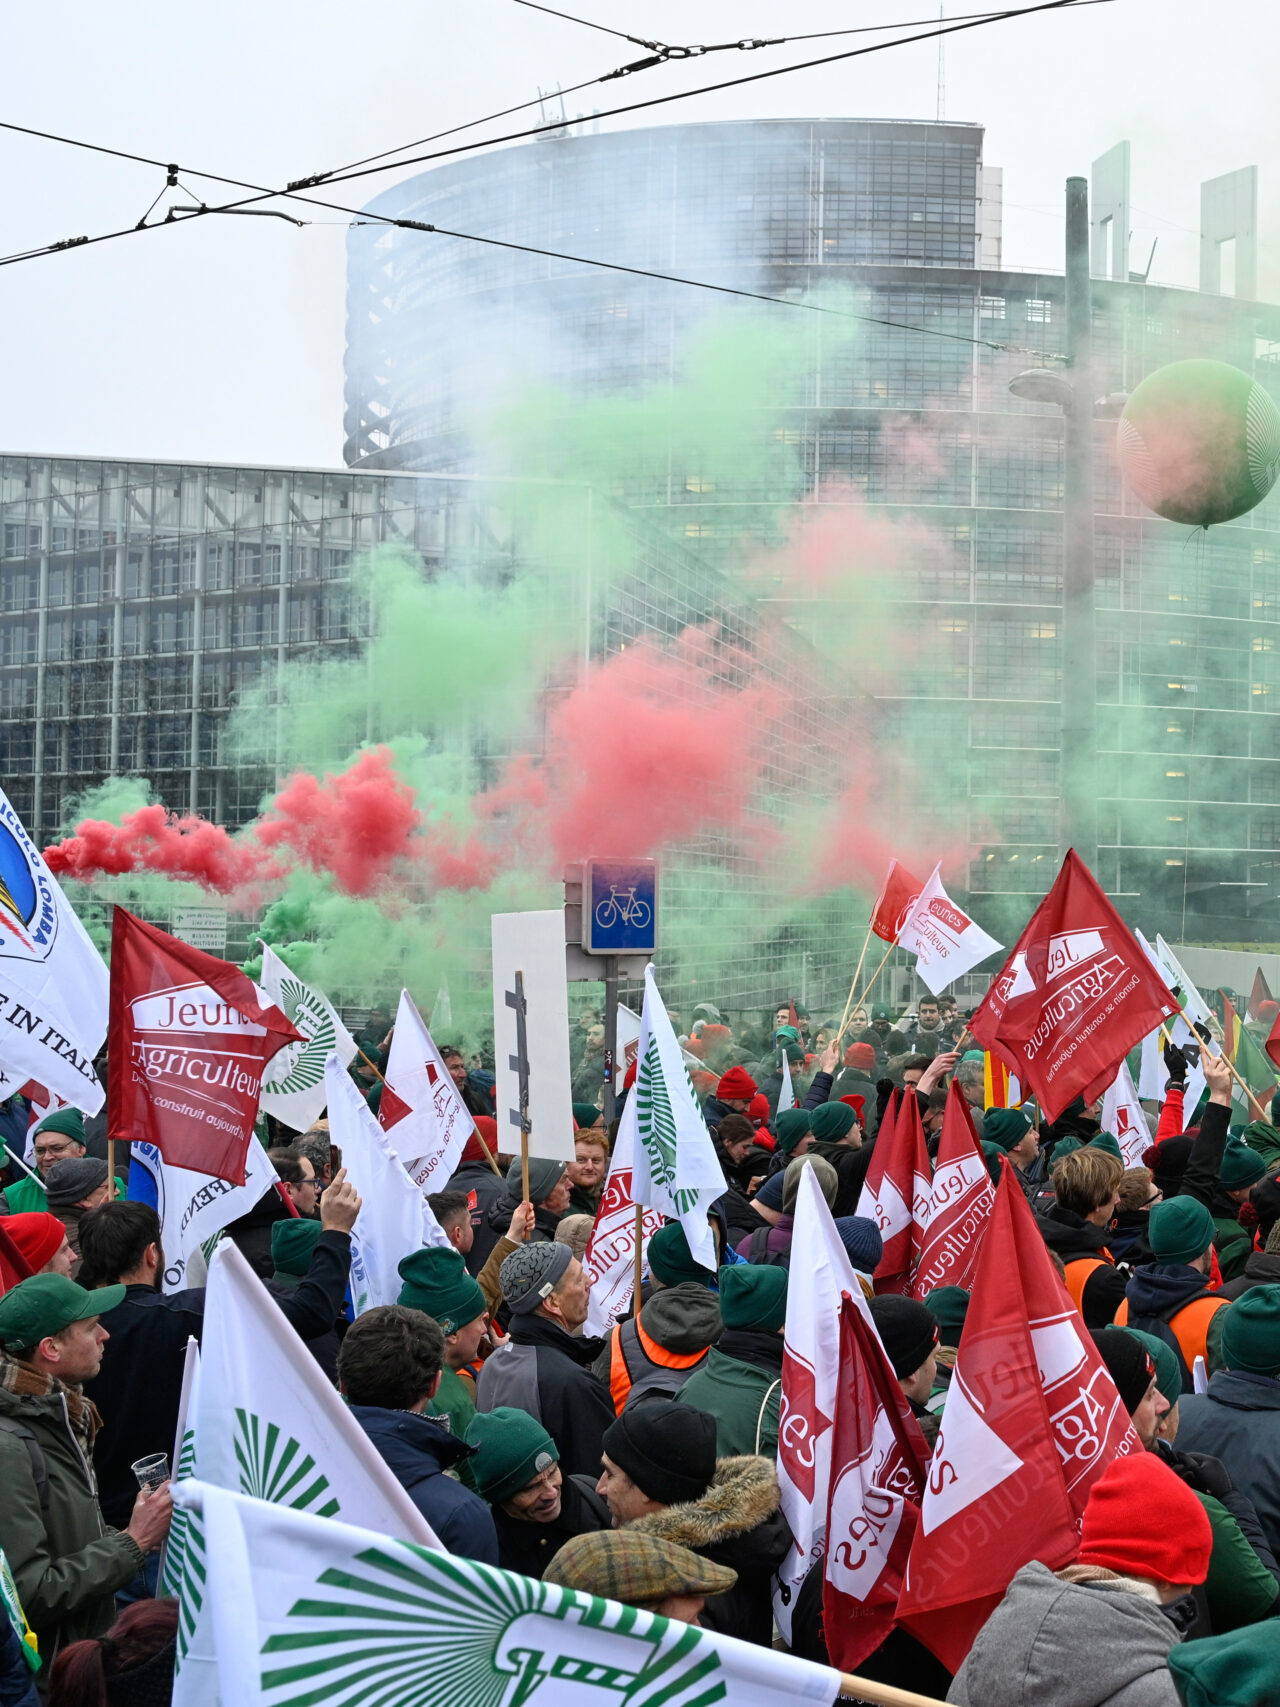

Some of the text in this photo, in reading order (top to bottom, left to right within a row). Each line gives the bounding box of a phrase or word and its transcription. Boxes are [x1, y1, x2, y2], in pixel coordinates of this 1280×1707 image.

[6, 1004, 43, 1035] IN
[40, 1026, 99, 1087] ITALY
[154, 1095, 206, 1120] construit
